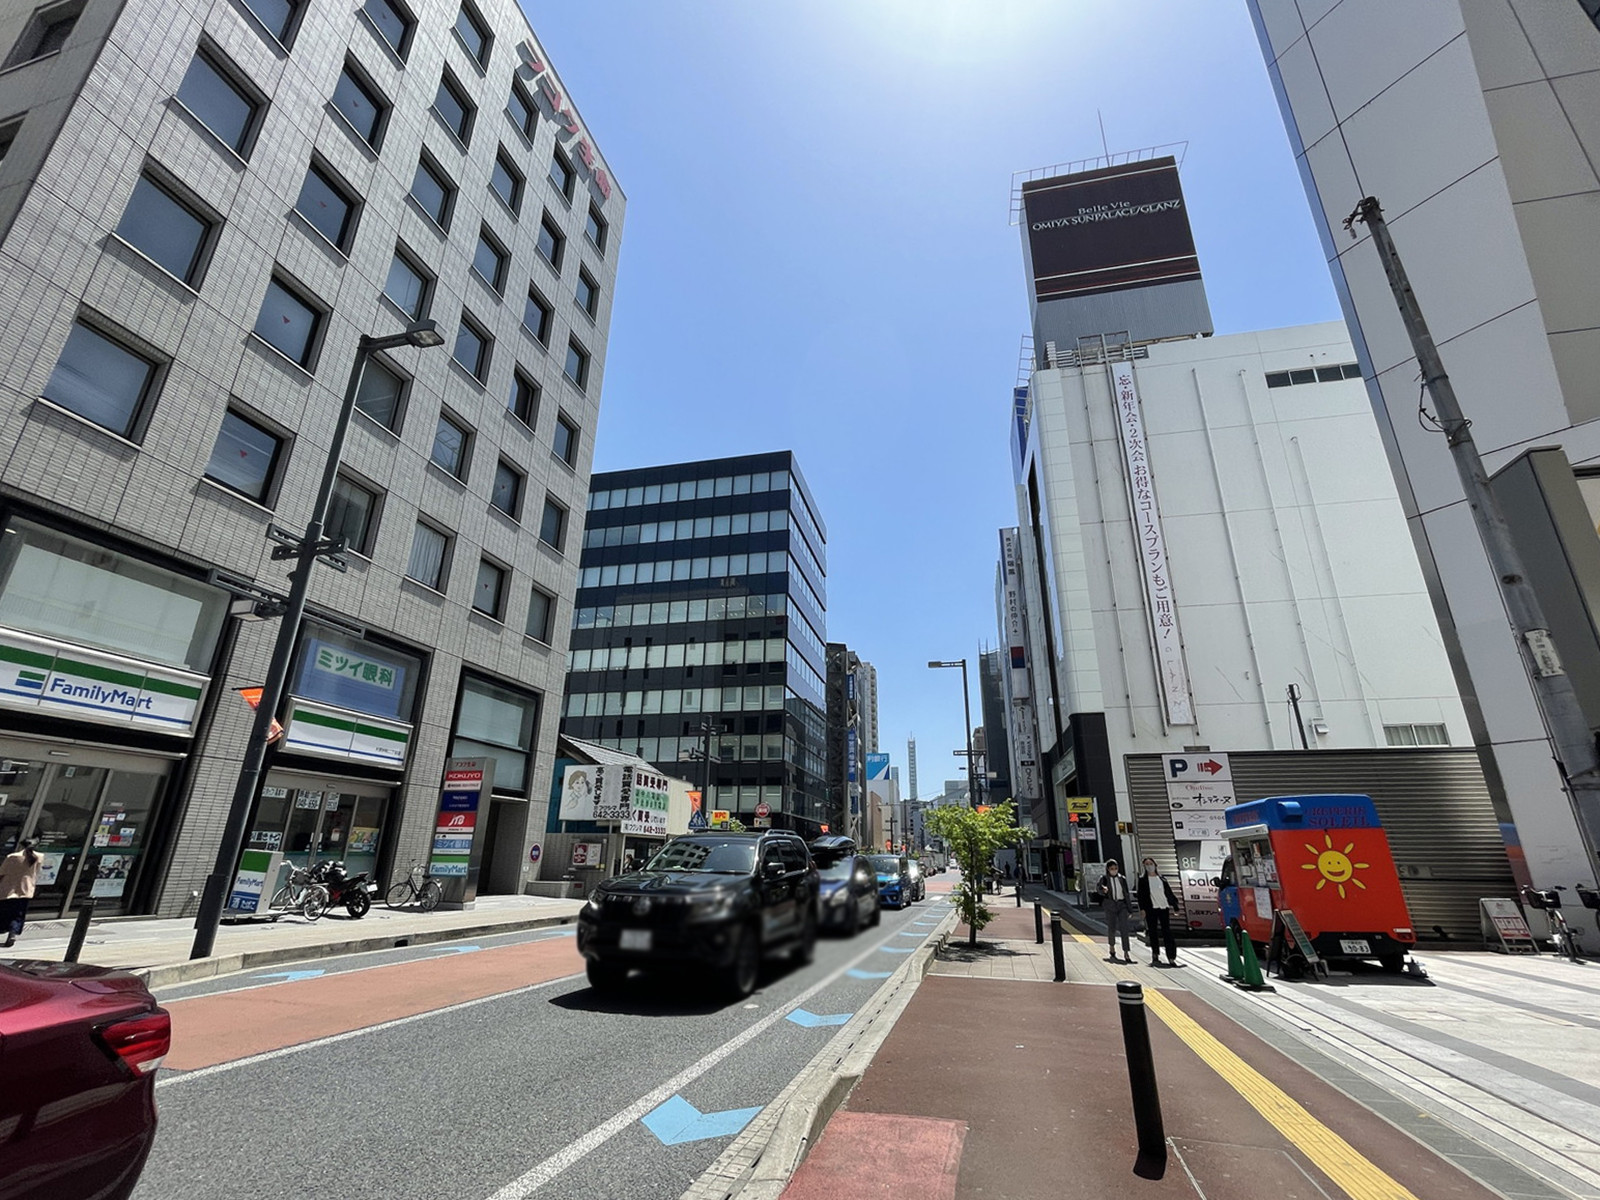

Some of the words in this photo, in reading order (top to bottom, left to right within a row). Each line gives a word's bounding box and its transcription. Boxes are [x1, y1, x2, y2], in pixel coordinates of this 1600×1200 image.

[1078, 204, 1108, 215] Belle
[1110, 200, 1131, 209] Vie
[1032, 218, 1069, 231] OMIYA
[318, 649, 393, 688] ミツイ眼科
[49, 677, 153, 710] FamilyMart
[1169, 758, 1188, 778] P
[448, 814, 465, 827] JTB
[592, 810, 631, 819] 642-3333
[1308, 816, 1370, 826] SOLEIL
[643, 825, 667, 835] 642-3333
[431, 864, 467, 874] FamilyMart
[1181, 856, 1197, 869] 8F
[237, 876, 263, 888] FamilyMart
